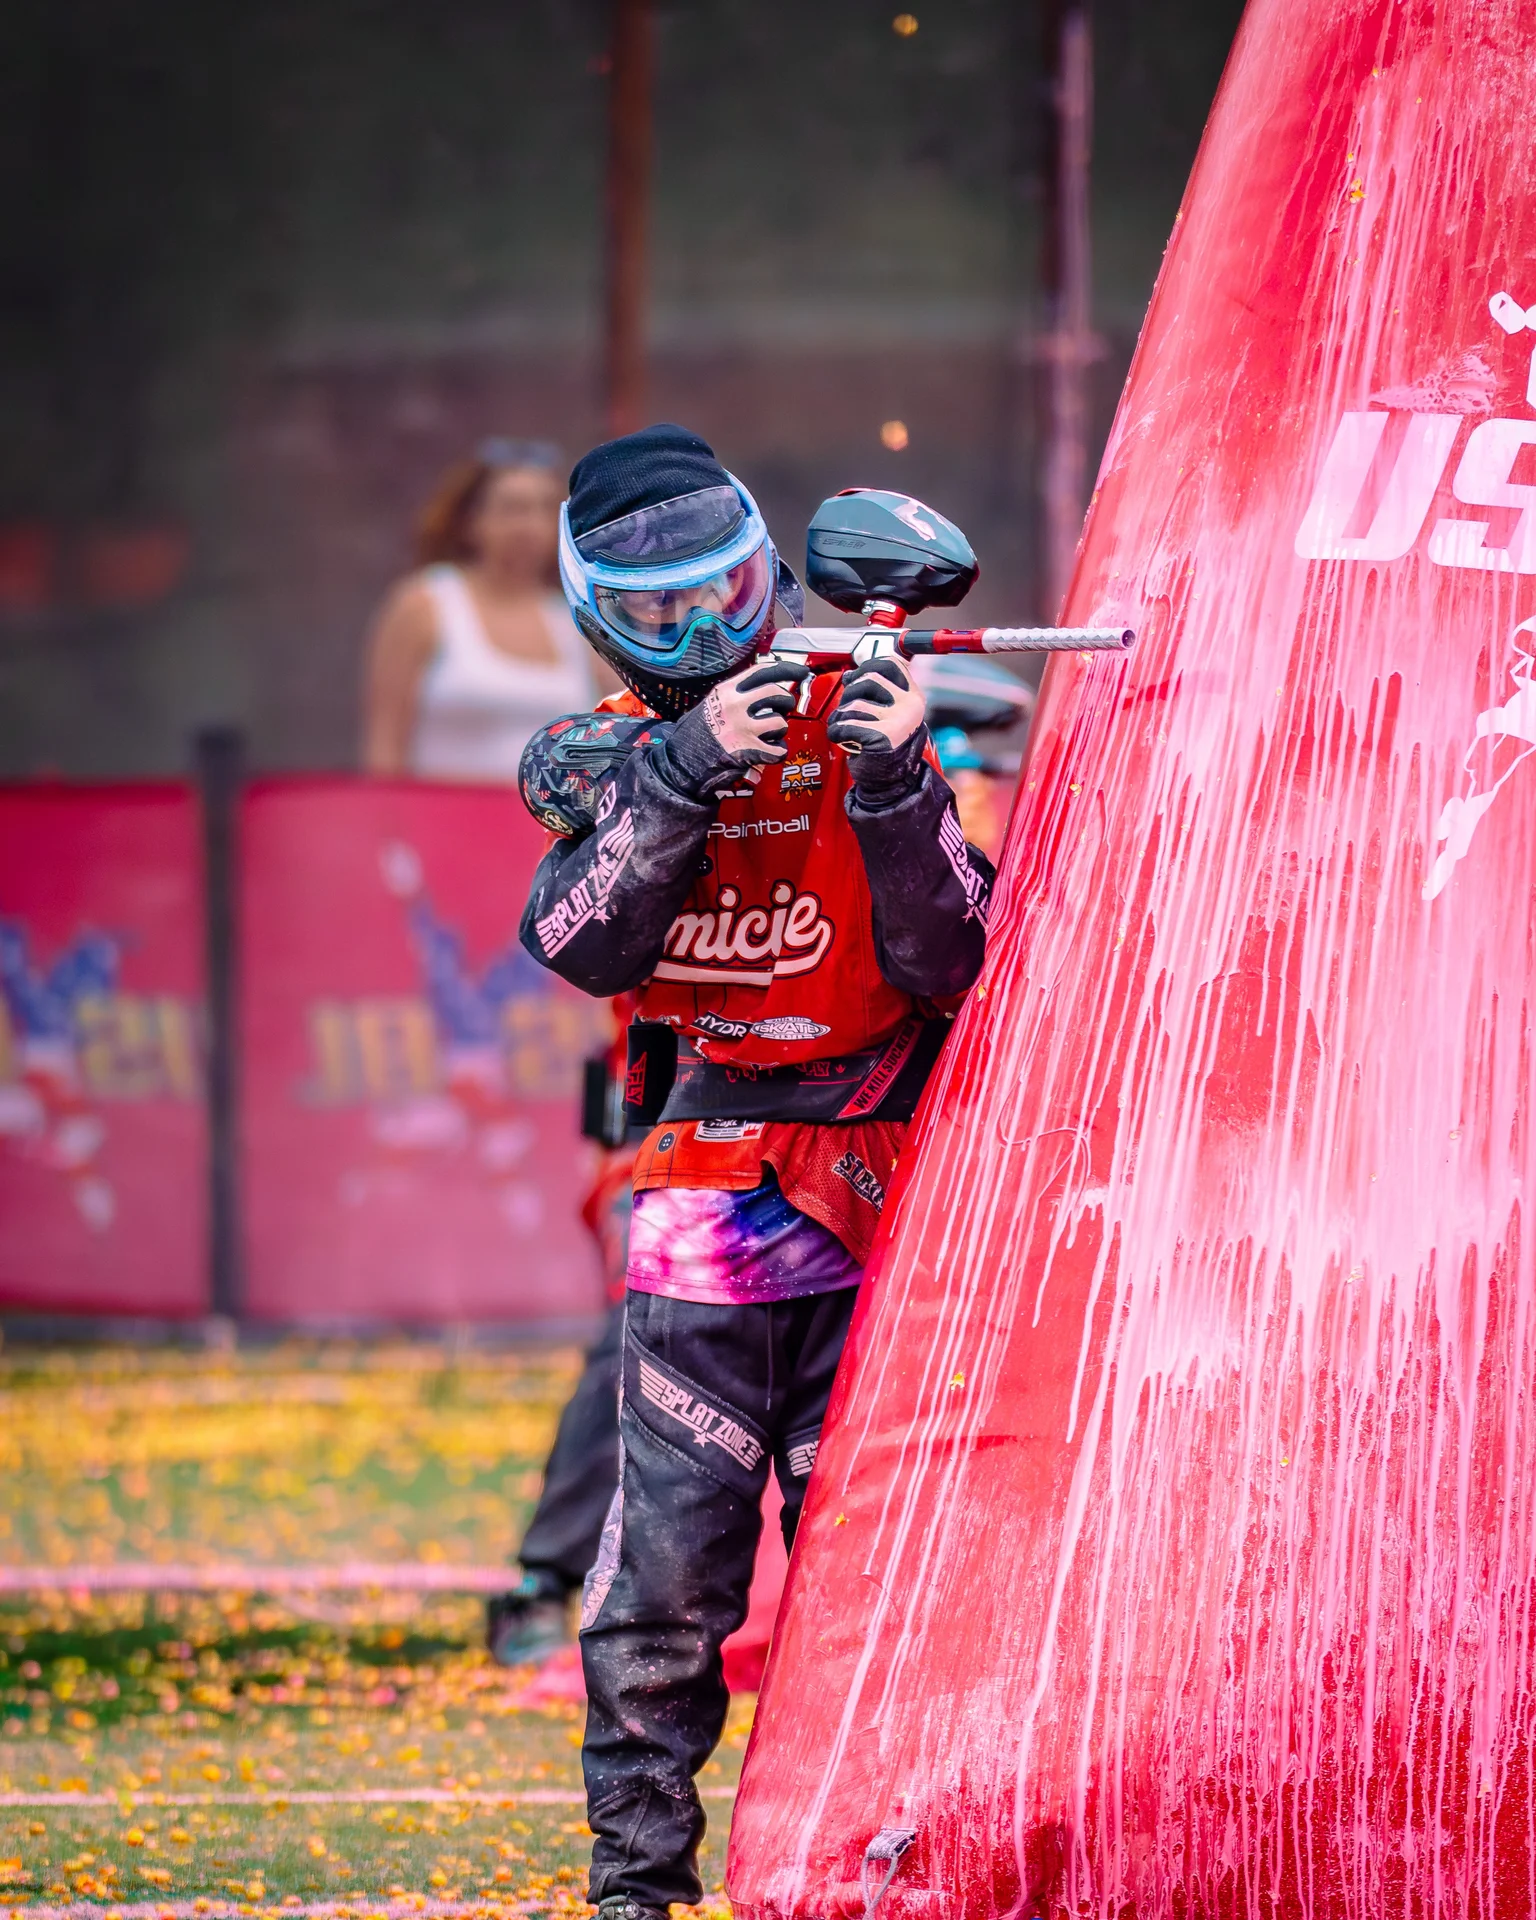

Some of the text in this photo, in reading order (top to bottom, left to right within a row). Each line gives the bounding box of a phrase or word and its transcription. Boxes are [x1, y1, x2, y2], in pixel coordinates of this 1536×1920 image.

[781, 778, 821, 788] BALL
[707, 814, 810, 839] Paintball
[551, 876, 595, 940] SPLAT
[759, 1021, 816, 1034] SKATE
[854, 1090, 873, 1110] WE
[866, 1070, 888, 1094] KILL
[660, 1382, 718, 1432] SPLAT
[713, 1415, 750, 1457] ZONE
